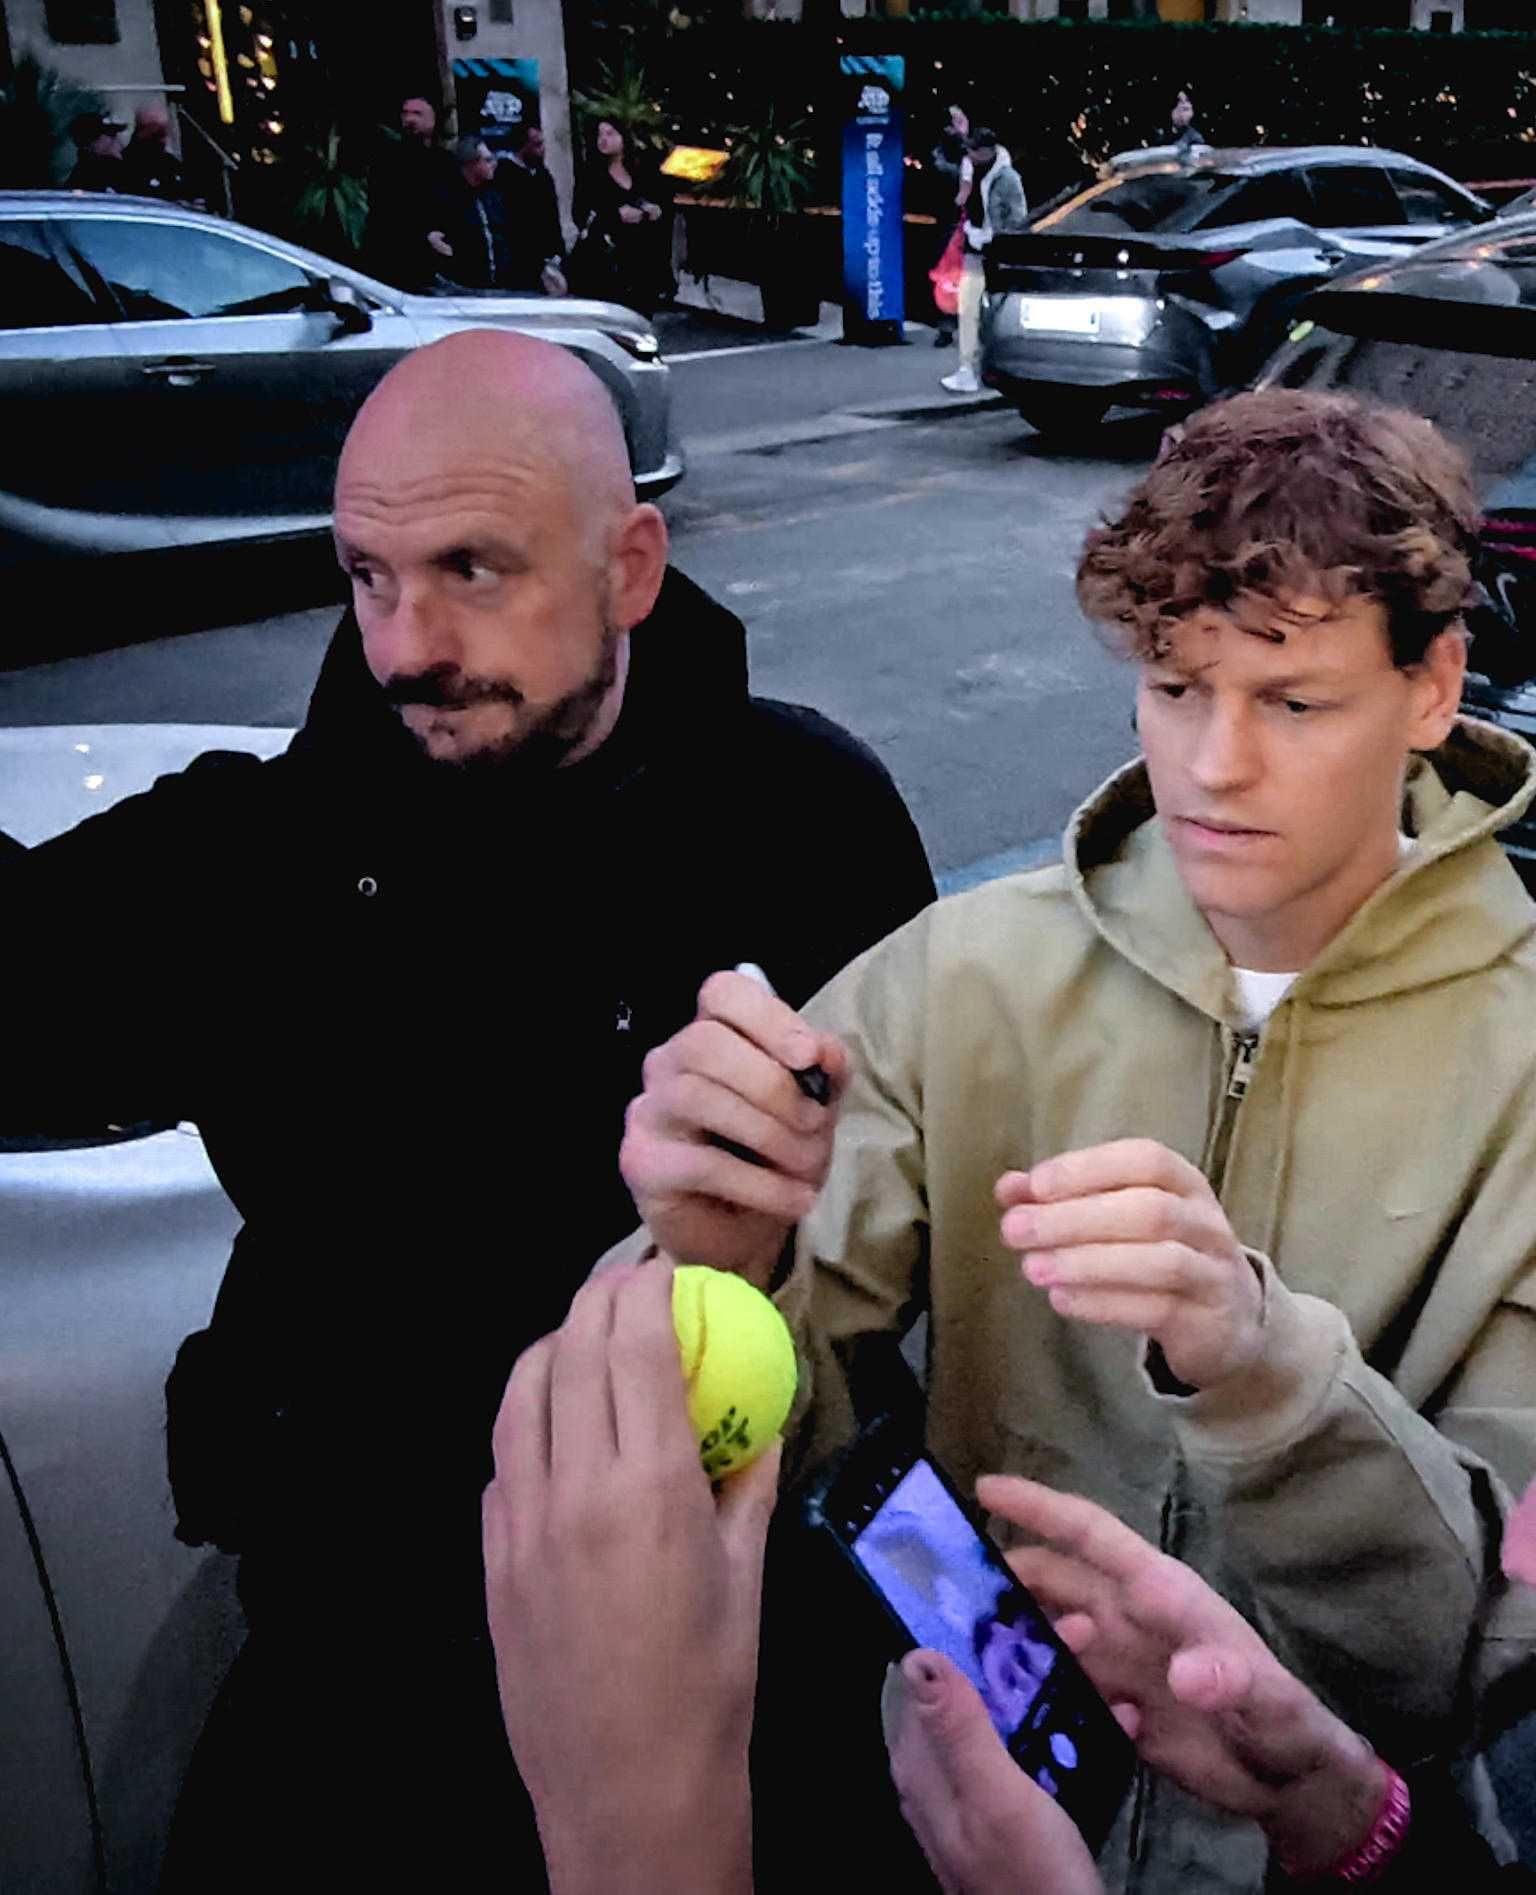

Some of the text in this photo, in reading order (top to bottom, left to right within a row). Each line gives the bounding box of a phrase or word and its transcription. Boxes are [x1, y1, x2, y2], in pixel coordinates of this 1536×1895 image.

[866, 150, 883, 176] all
[866, 177, 884, 227] adds
[864, 228, 882, 256] up
[867, 256, 882, 279] to
[867, 279, 884, 320] this
